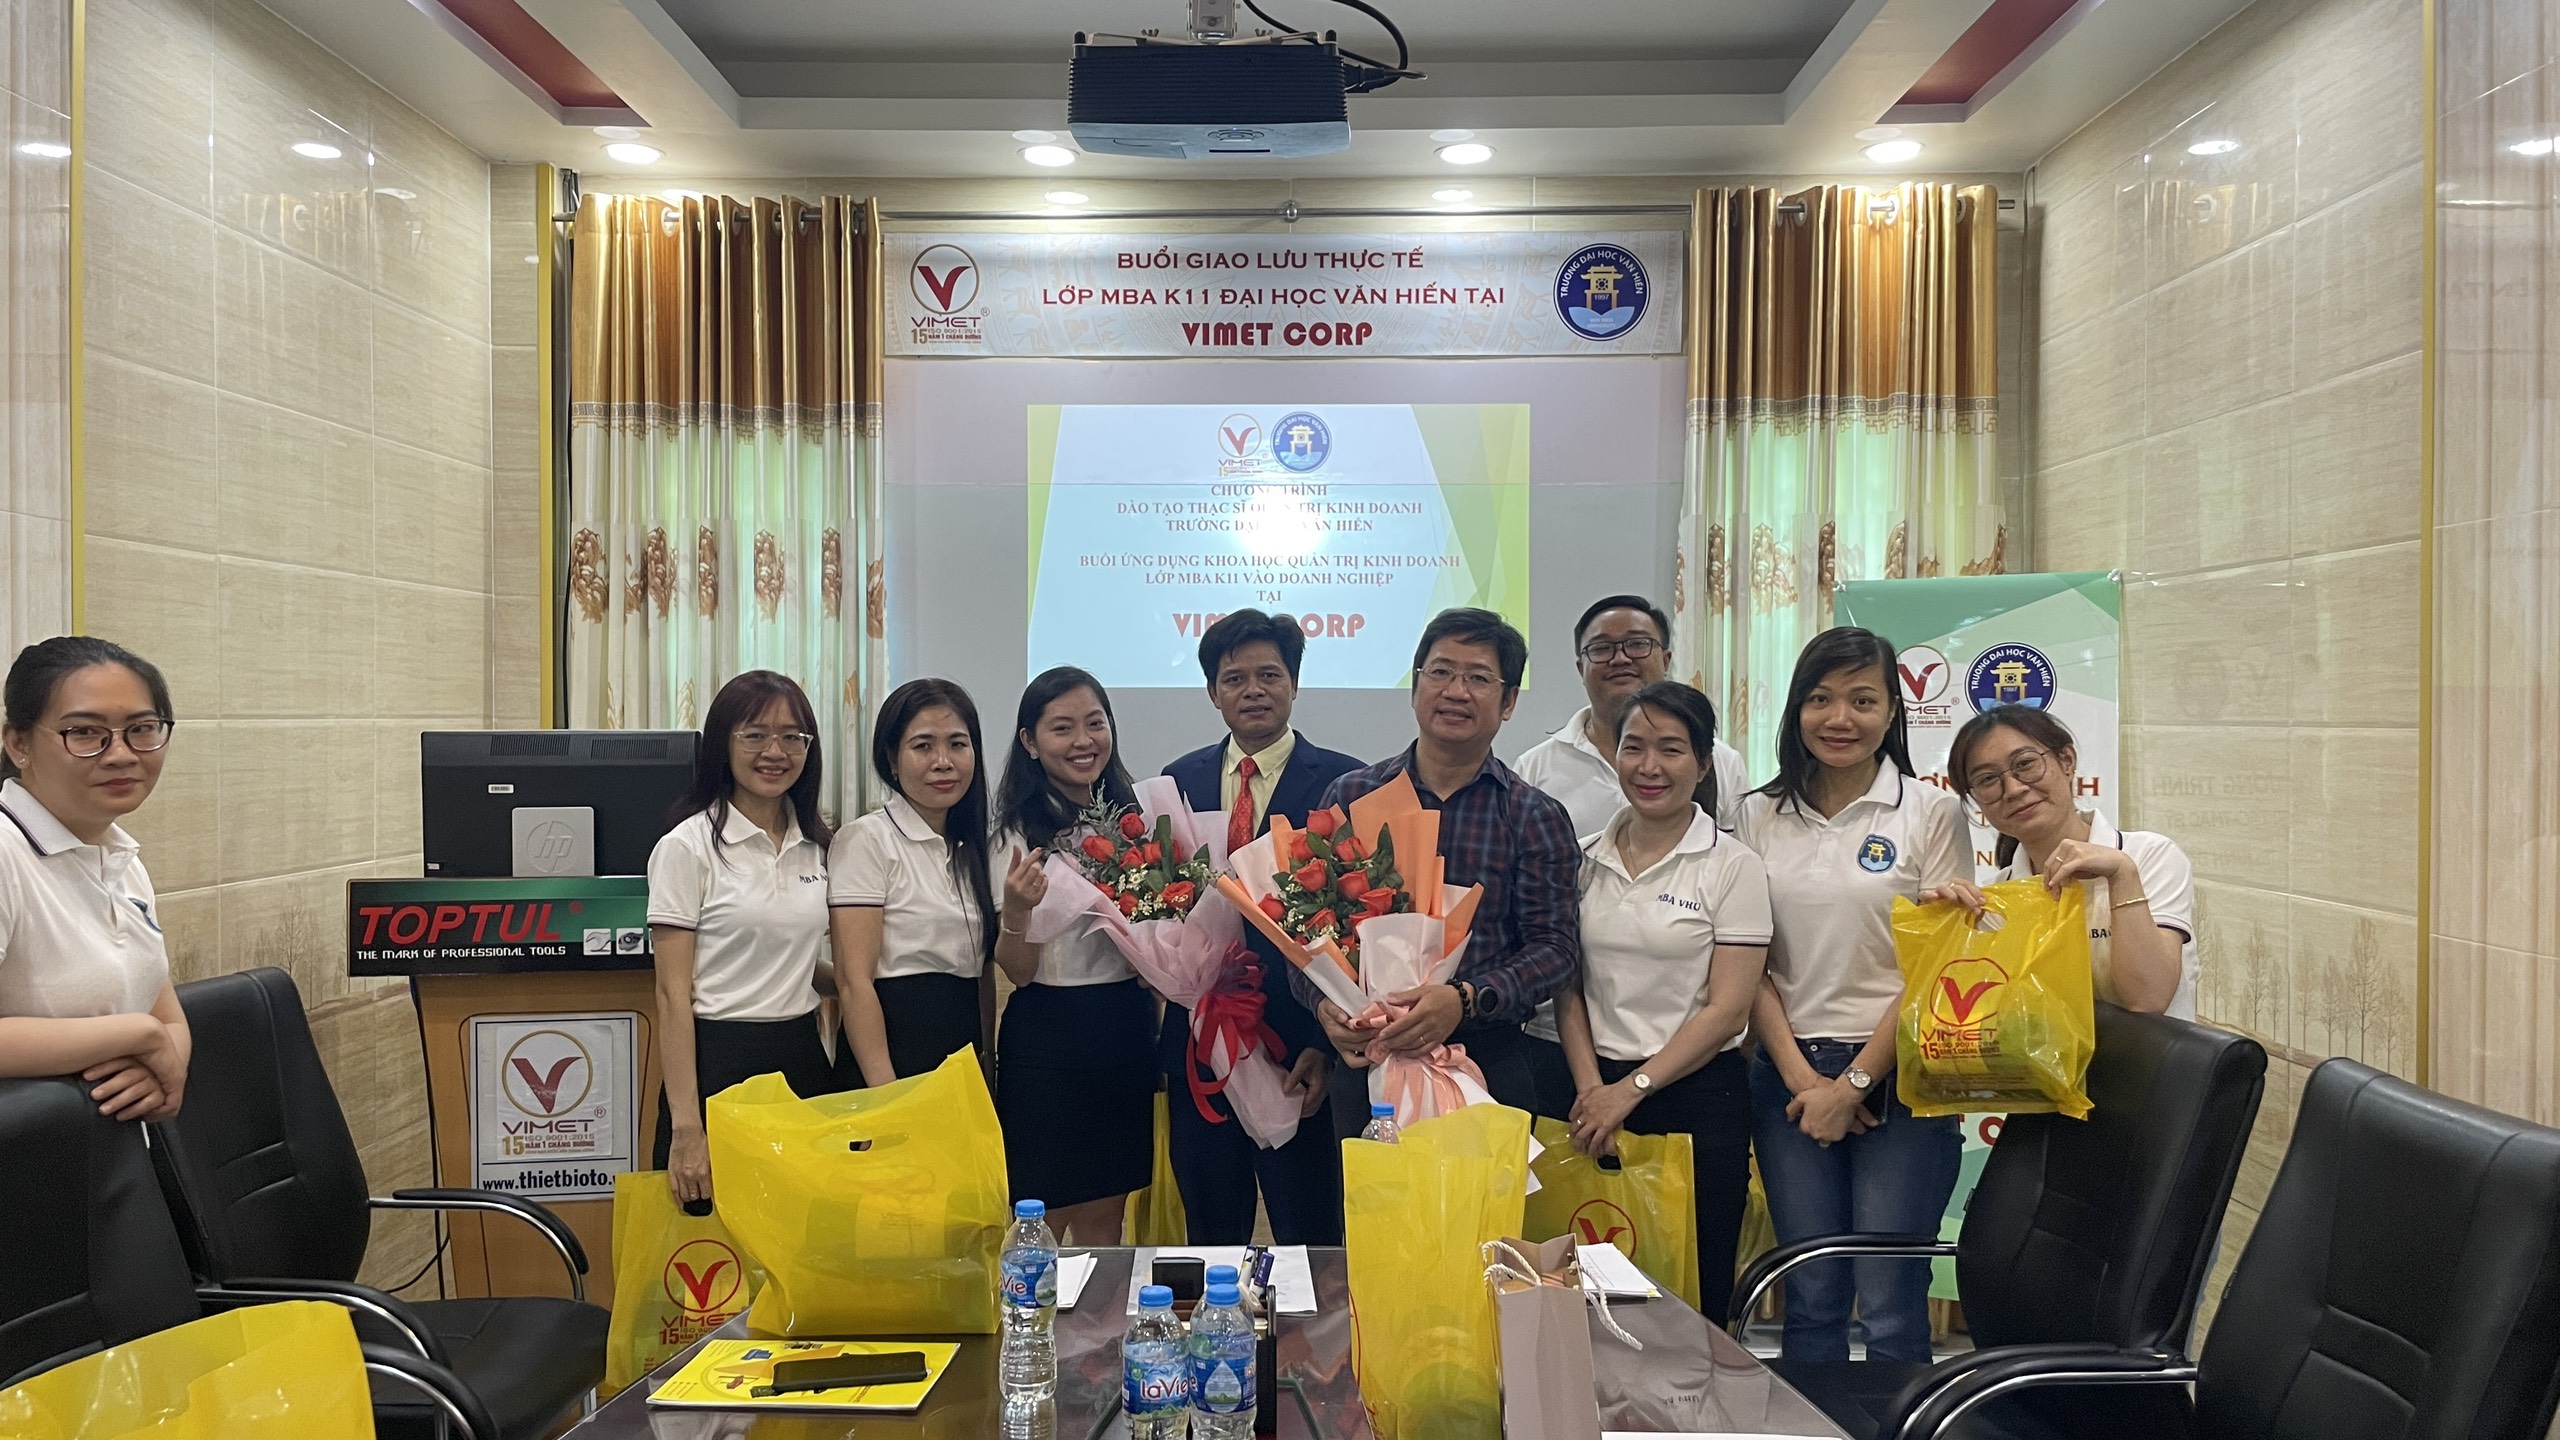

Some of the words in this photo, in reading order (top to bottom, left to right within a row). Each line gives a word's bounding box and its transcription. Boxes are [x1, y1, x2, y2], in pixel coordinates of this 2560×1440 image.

[1117, 245, 1178, 269] BUỔI
[1186, 253, 1249, 269] GIAO
[1257, 249, 1307, 269] LƯU
[1314, 249, 1385, 272] THỰC
[1392, 245, 1424, 268] TẾ
[1043, 285, 1093, 305] LỚP
[1101, 289, 1157, 305] MBA
[1165, 289, 1209, 305] K11
[1220, 288, 1263, 309] ĐẠI
[1271, 288, 1326, 308] HỌC
[1334, 285, 1387, 304] VĂN
[1396, 282, 1456, 304] HIẾN
[1464, 288, 1504, 307] TẠI
[911, 317, 981, 328] VIMET
[911, 328, 928, 344] 15
[1182, 322, 1273, 347] VIMET
[1283, 322, 1373, 346] CORP
[1218, 459, 1262, 467] VIMET
[1117, 500, 1149, 514] ĐÀO
[1153, 502, 1183, 516] TẠO
[1188, 502, 1229, 516] THẠC
[1327, 502, 1364, 514] KINH
[1368, 502, 1422, 514] DOANH
[1166, 517, 1230, 532] TRƯỜNG
[1121, 552, 1153, 567] ỨNG
[1158, 555, 1200, 569] DỤNG
[1204, 555, 1248, 567] KHOA
[1251, 555, 1283, 569] HỌC
[1288, 552, 1329, 568] QUẢN
[1333, 555, 1358, 569] TRỊ
[1363, 555, 1402, 567] KINH
[1406, 555, 1460, 567] DOANH
[1145, 570, 1175, 584] LỚP
[1178, 573, 1212, 584] MBA
[1215, 573, 1239, 584] K11
[1243, 570, 1275, 584] VÀO
[1279, 573, 1332, 584] DOANH
[1337, 571, 1393, 587] NGHIỆP
[1256, 590, 1282, 604] TẠI
[1299, 613, 1365, 638] ORP
[1904, 705, 1951, 714] MET
[1679, 899, 1701, 911] VHU
[359, 903, 561, 945] TOPTUL
[2089, 928, 2107, 939] BA
[357, 950, 378, 960] THE
[382, 949, 419, 959] MARK
[424, 949, 437, 959] OF
[441, 947, 525, 959] PROFESSIONAL
[529, 946, 566, 956] TOOLS
[1921, 1028, 1997, 1042] VIMET
[1921, 1042, 1940, 1060] 15
[502, 1119, 594, 1135] VIMET
[502, 1135, 525, 1155] 15
[483, 1169, 615, 1190] www.thietbioto.
[1001, 1273, 1025, 1294] Vie
[660, 1328, 680, 1345] 15
[1141, 1376, 1188, 1398] laVie
